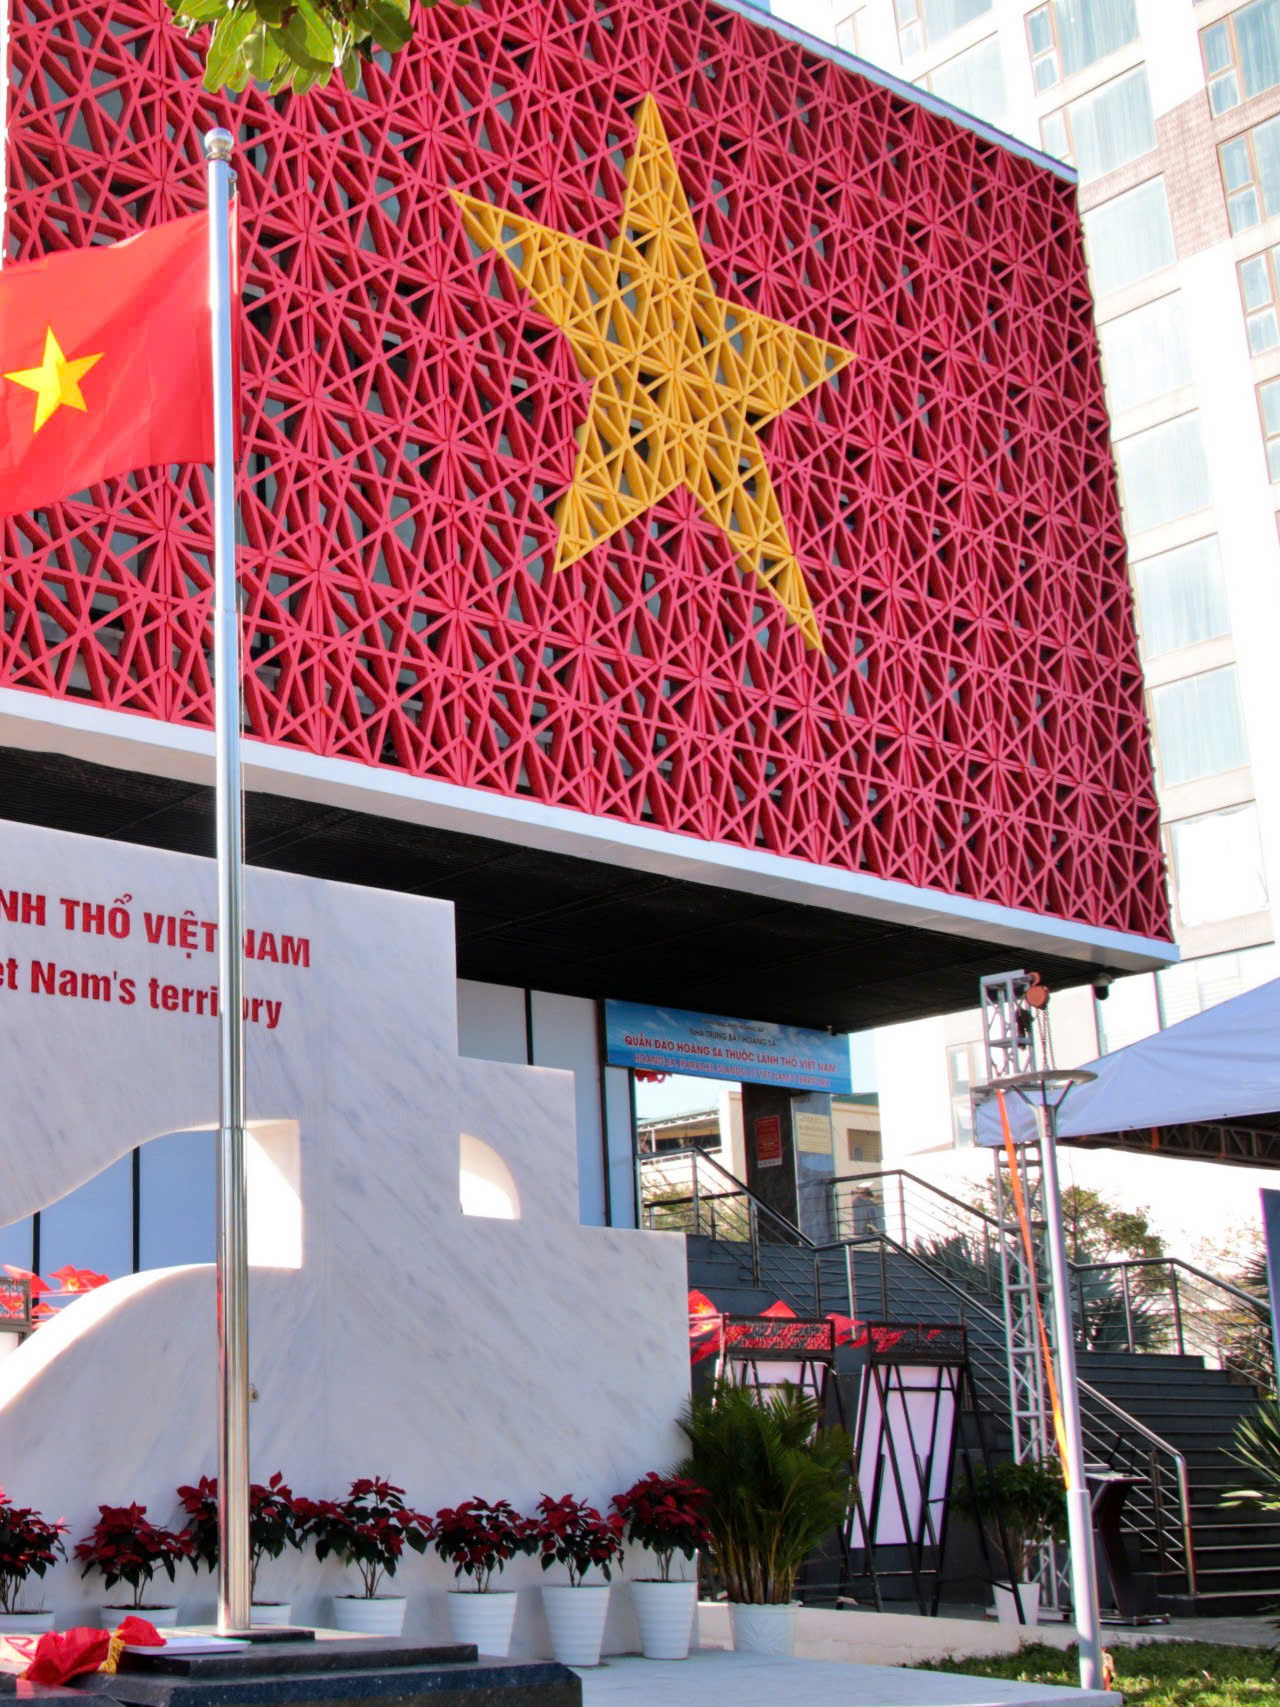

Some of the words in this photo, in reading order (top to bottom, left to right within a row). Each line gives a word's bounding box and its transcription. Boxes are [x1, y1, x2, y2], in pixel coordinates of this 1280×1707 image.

[60, 893, 133, 939] THỔ
[143, 910, 219, 959] VIỆT
[30, 959, 136, 1005] Nam's
[148, 977, 282, 1029] terriry
